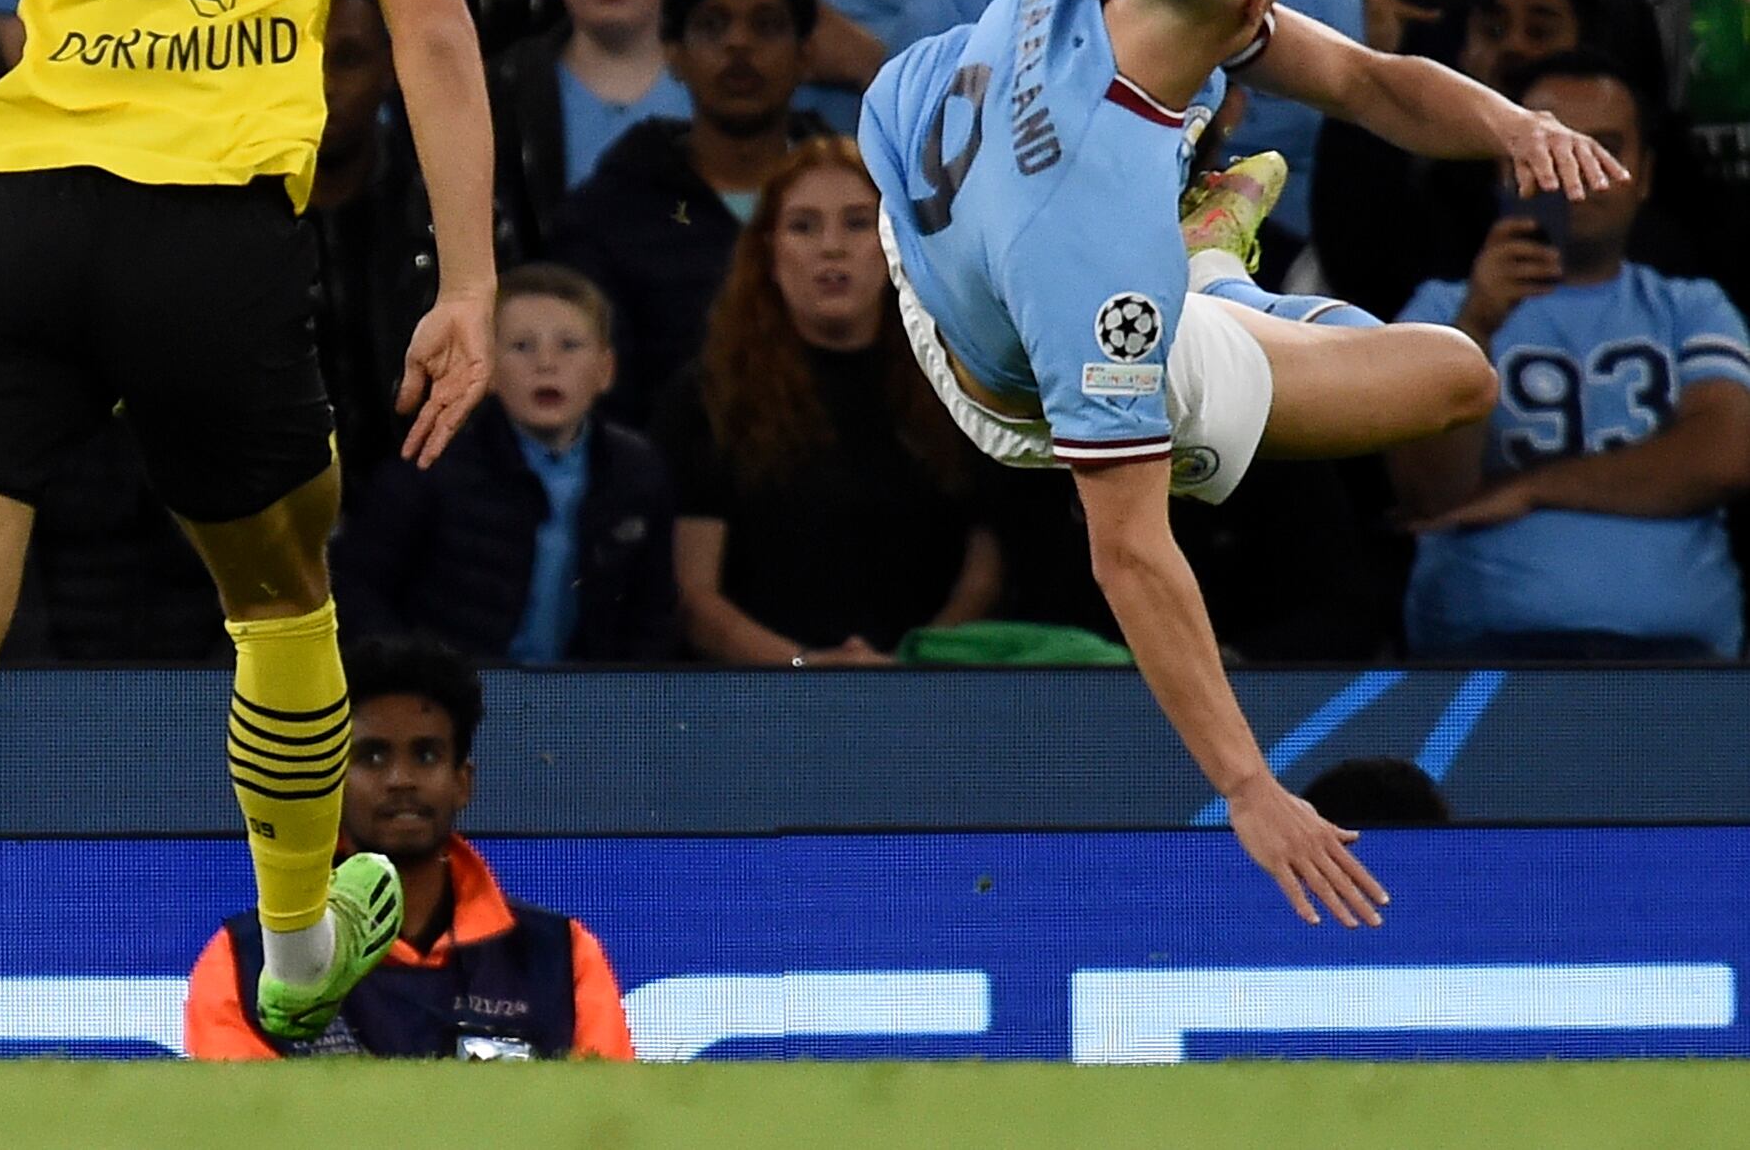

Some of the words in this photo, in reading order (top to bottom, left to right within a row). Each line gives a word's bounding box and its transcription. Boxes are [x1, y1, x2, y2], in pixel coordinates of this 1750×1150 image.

[48, 16, 298, 72] DORTMUND
[910, 61, 993, 237] 9
[1498, 336, 1680, 472] 93
